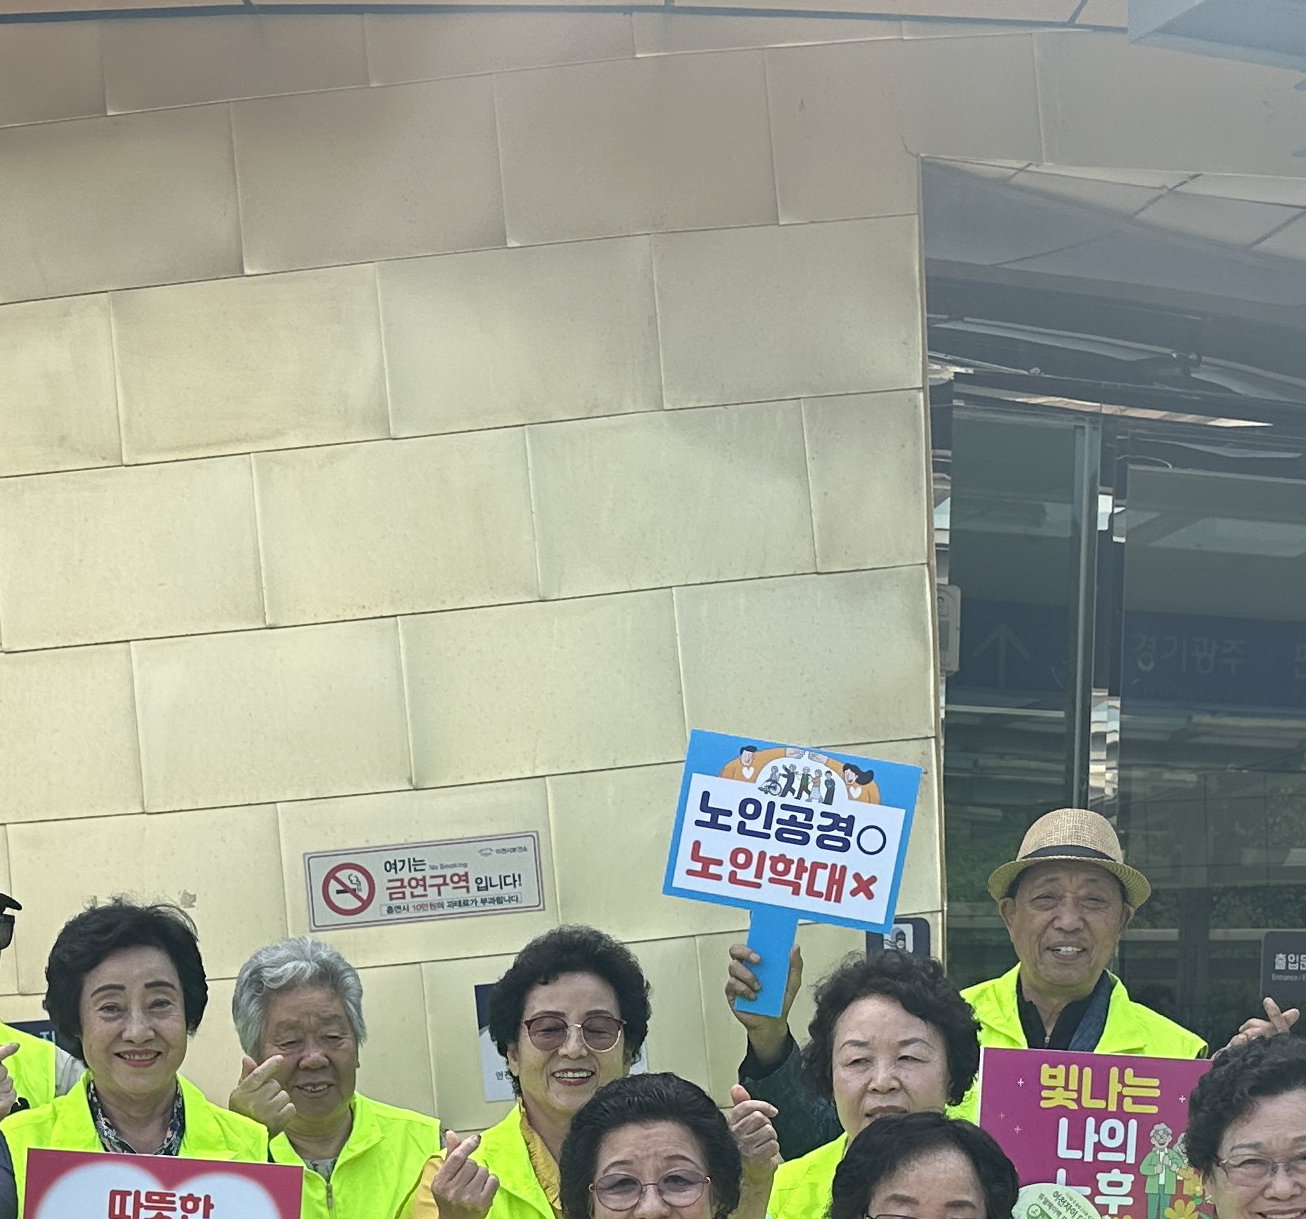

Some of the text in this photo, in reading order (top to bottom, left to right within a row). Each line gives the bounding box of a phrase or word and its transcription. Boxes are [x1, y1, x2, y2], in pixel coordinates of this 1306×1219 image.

[1130, 632, 1248, 675] 경기광주
[384, 857, 427, 874] 여기는
[386, 871, 522, 901] 금연구역 입니다!
[1040, 1063, 1161, 1113] 빛나는
[1057, 1116, 1138, 1164] 나의
